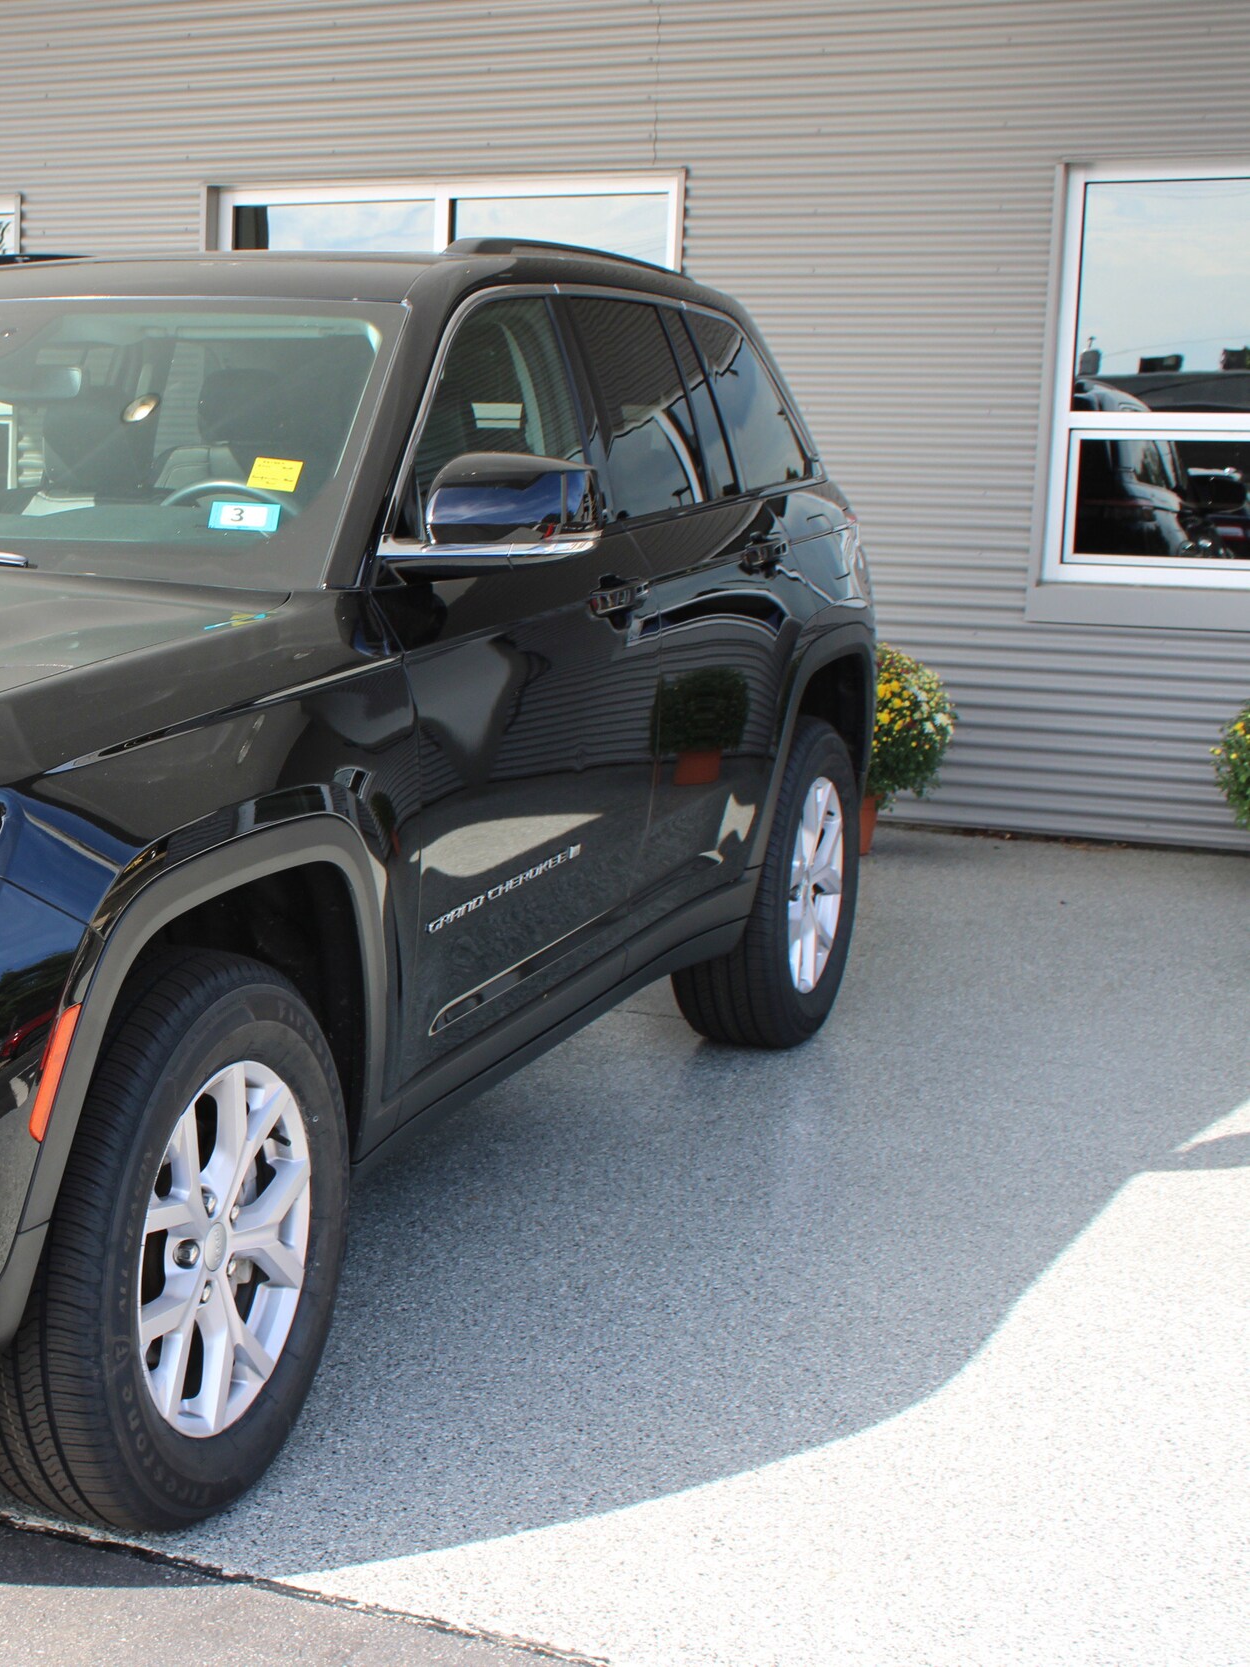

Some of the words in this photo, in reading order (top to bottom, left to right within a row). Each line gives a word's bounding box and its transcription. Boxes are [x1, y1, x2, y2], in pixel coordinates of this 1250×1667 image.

[230, 507, 245, 522] 3
[425, 894, 487, 934] GRAND
[485, 850, 570, 901] CHEROKEE
